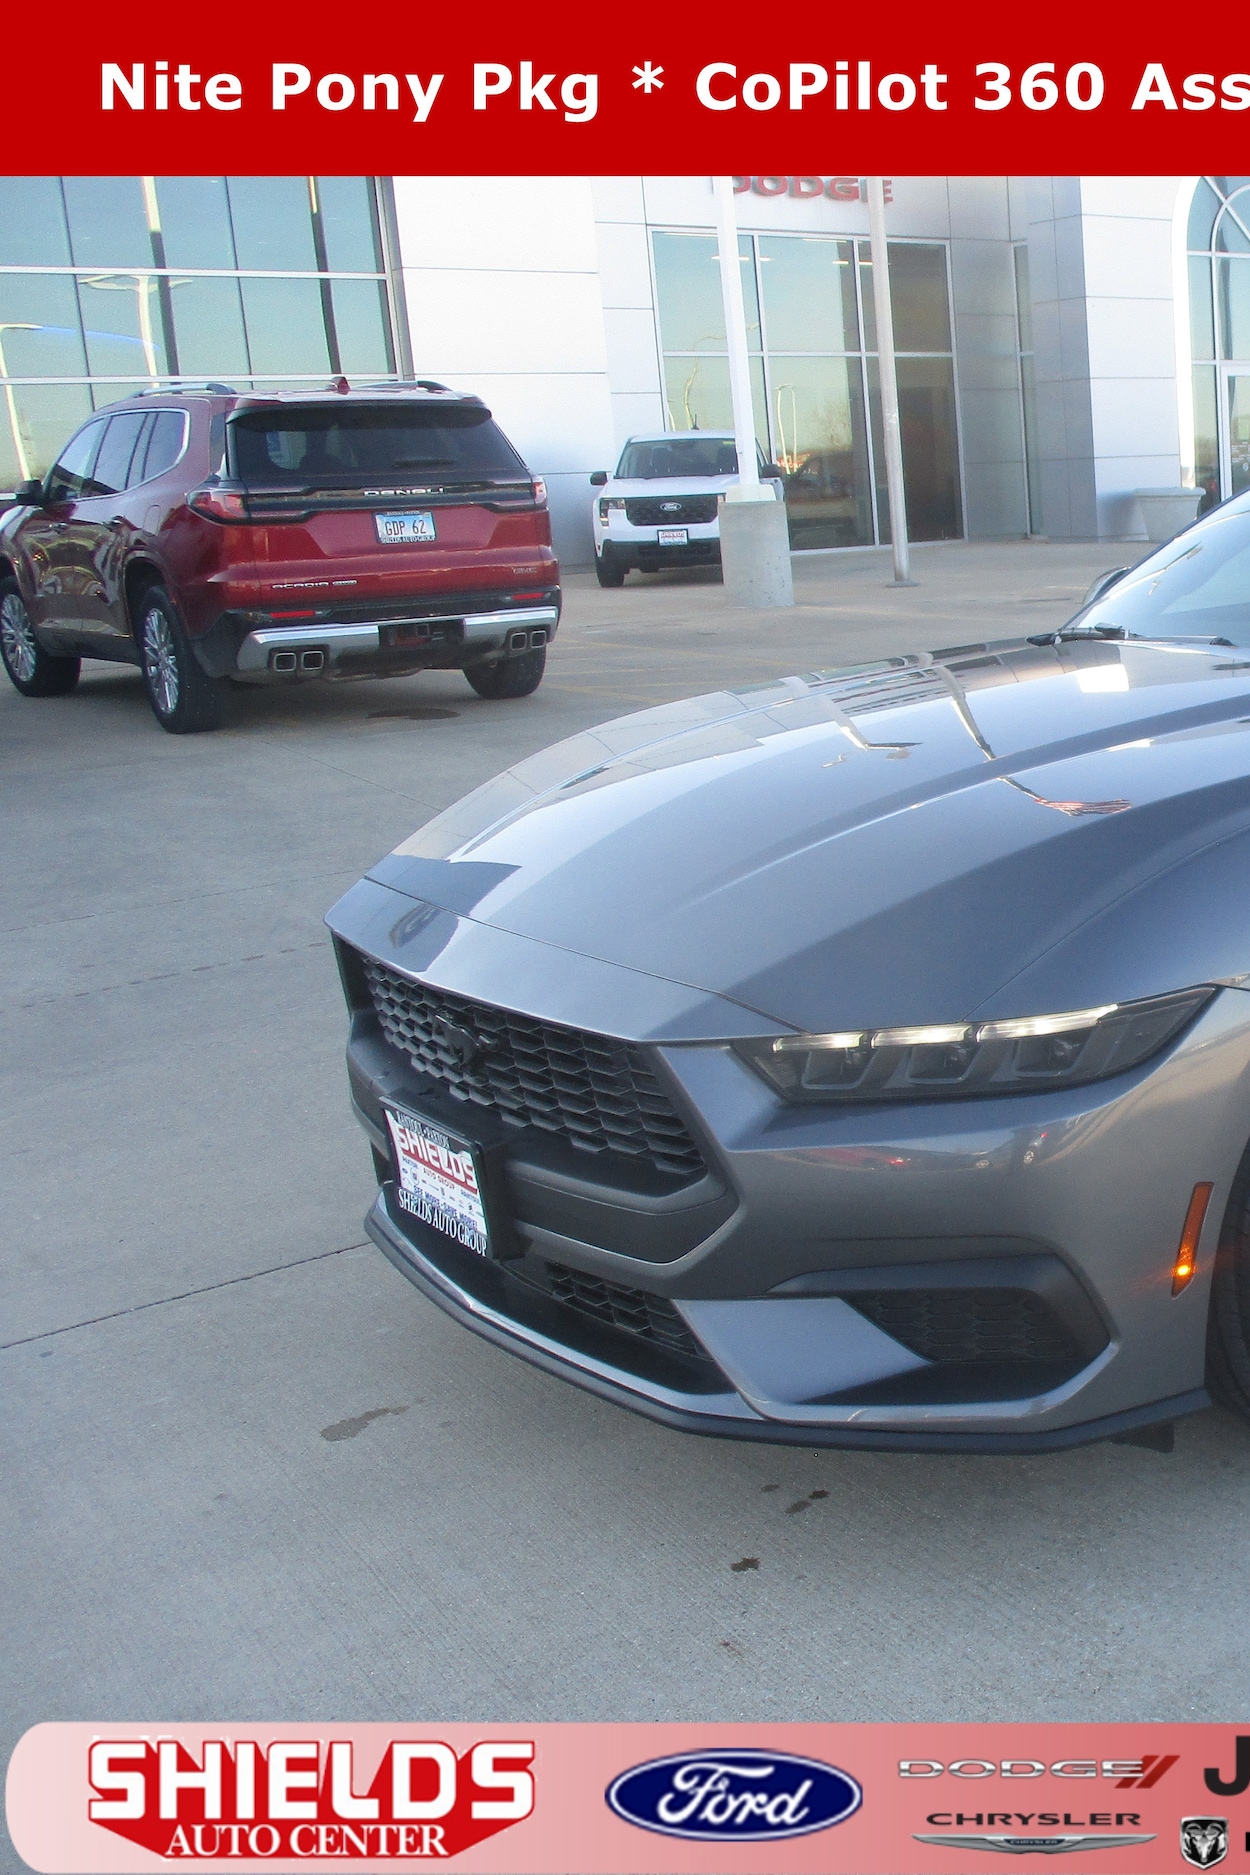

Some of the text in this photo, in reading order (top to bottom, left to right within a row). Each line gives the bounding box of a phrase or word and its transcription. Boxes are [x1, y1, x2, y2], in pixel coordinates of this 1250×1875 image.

[363, 487, 444, 497] DENALI
[384, 519, 427, 537] GDP 62
[272, 581, 329, 589] ACADIA
[398, 1125, 478, 1188] SHIELDS
[423, 1167, 437, 1180] AUTO
[398, 1188, 487, 1258] SHIELDS AUTO GROUP
